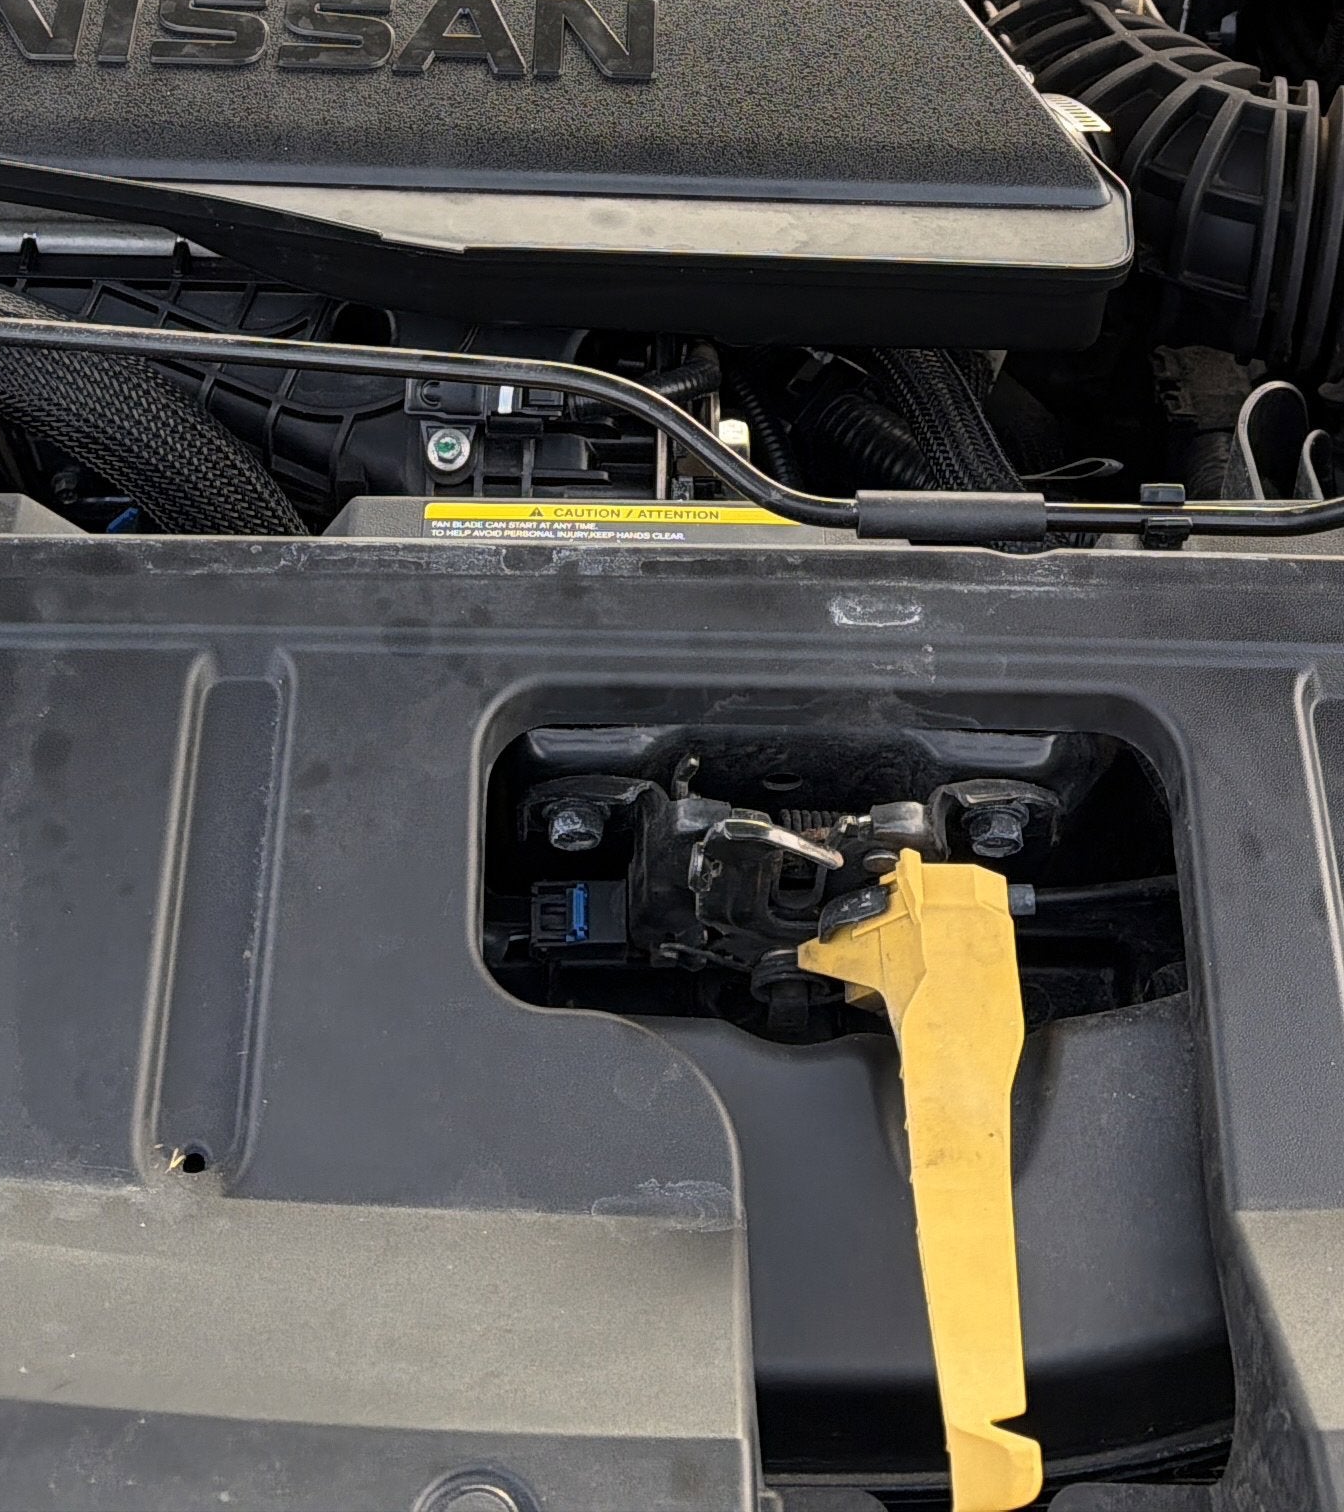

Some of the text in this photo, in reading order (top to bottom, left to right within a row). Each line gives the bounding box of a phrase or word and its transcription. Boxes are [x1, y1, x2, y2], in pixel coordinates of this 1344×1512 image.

[553, 507, 621, 519] CAUTION
[637, 509, 720, 520] ATTENTION
[431, 520, 450, 529] FAN
[452, 521, 484, 529] BLADE
[485, 521, 507, 529] CAN
[508, 521, 537, 530] START
[538, 522, 552, 530] AT
[552, 522, 573, 530] ANY
[431, 529, 445, 537] TO
[446, 529, 471, 538] HELP
[472, 530, 503, 538] AVOID
[504, 530, 555, 538] PERSONAL
[617, 532, 651, 540] HANDS
